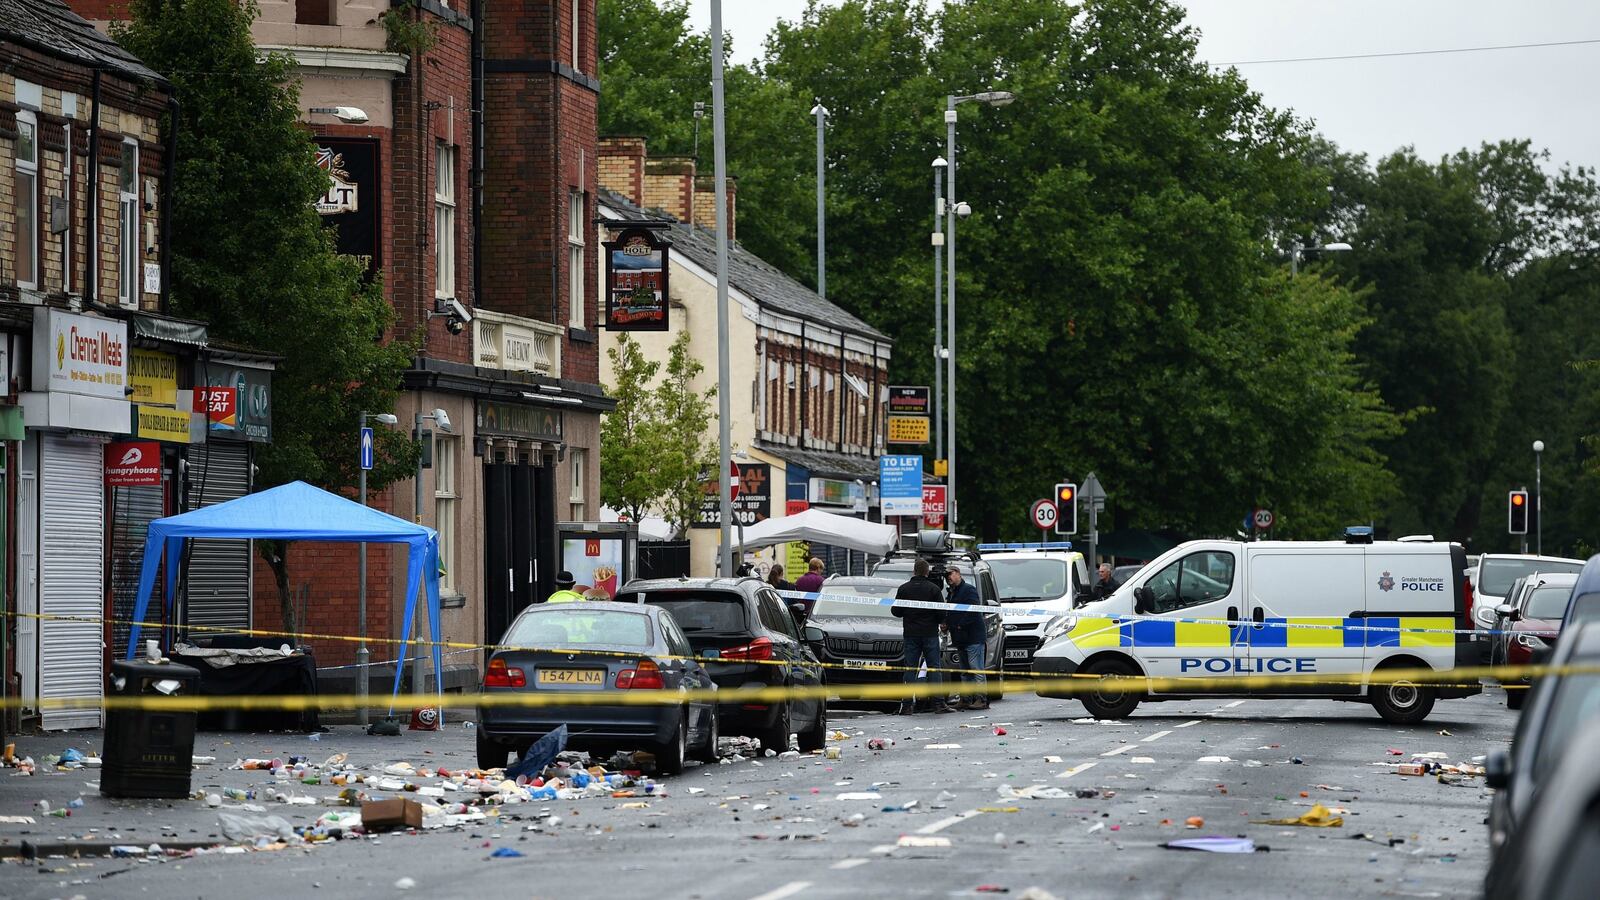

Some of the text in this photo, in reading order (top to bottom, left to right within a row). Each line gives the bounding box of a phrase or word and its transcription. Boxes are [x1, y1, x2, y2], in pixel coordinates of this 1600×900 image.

[70, 325, 122, 367] Chennai Meals
[506, 339, 530, 362] CLAREMONT
[141, 356, 159, 378] POUND
[160, 358, 175, 380] SHOP
[201, 391, 230, 402] JUST
[206, 402, 229, 412] EAT
[152, 414, 166, 431] REPAIR
[170, 416, 179, 432] HIRE
[883, 457, 919, 466] TO LET
[105, 466, 158, 476] hungryhouse
[922, 490, 936, 500] FF
[921, 503, 944, 511] ENCE
[1038, 509, 1055, 520] 30
[1257, 513, 1271, 522] 20
[1401, 583, 1443, 591] POLICE
[1180, 658, 1317, 673] POLICE
[541, 671, 601, 682] T547 LNA
